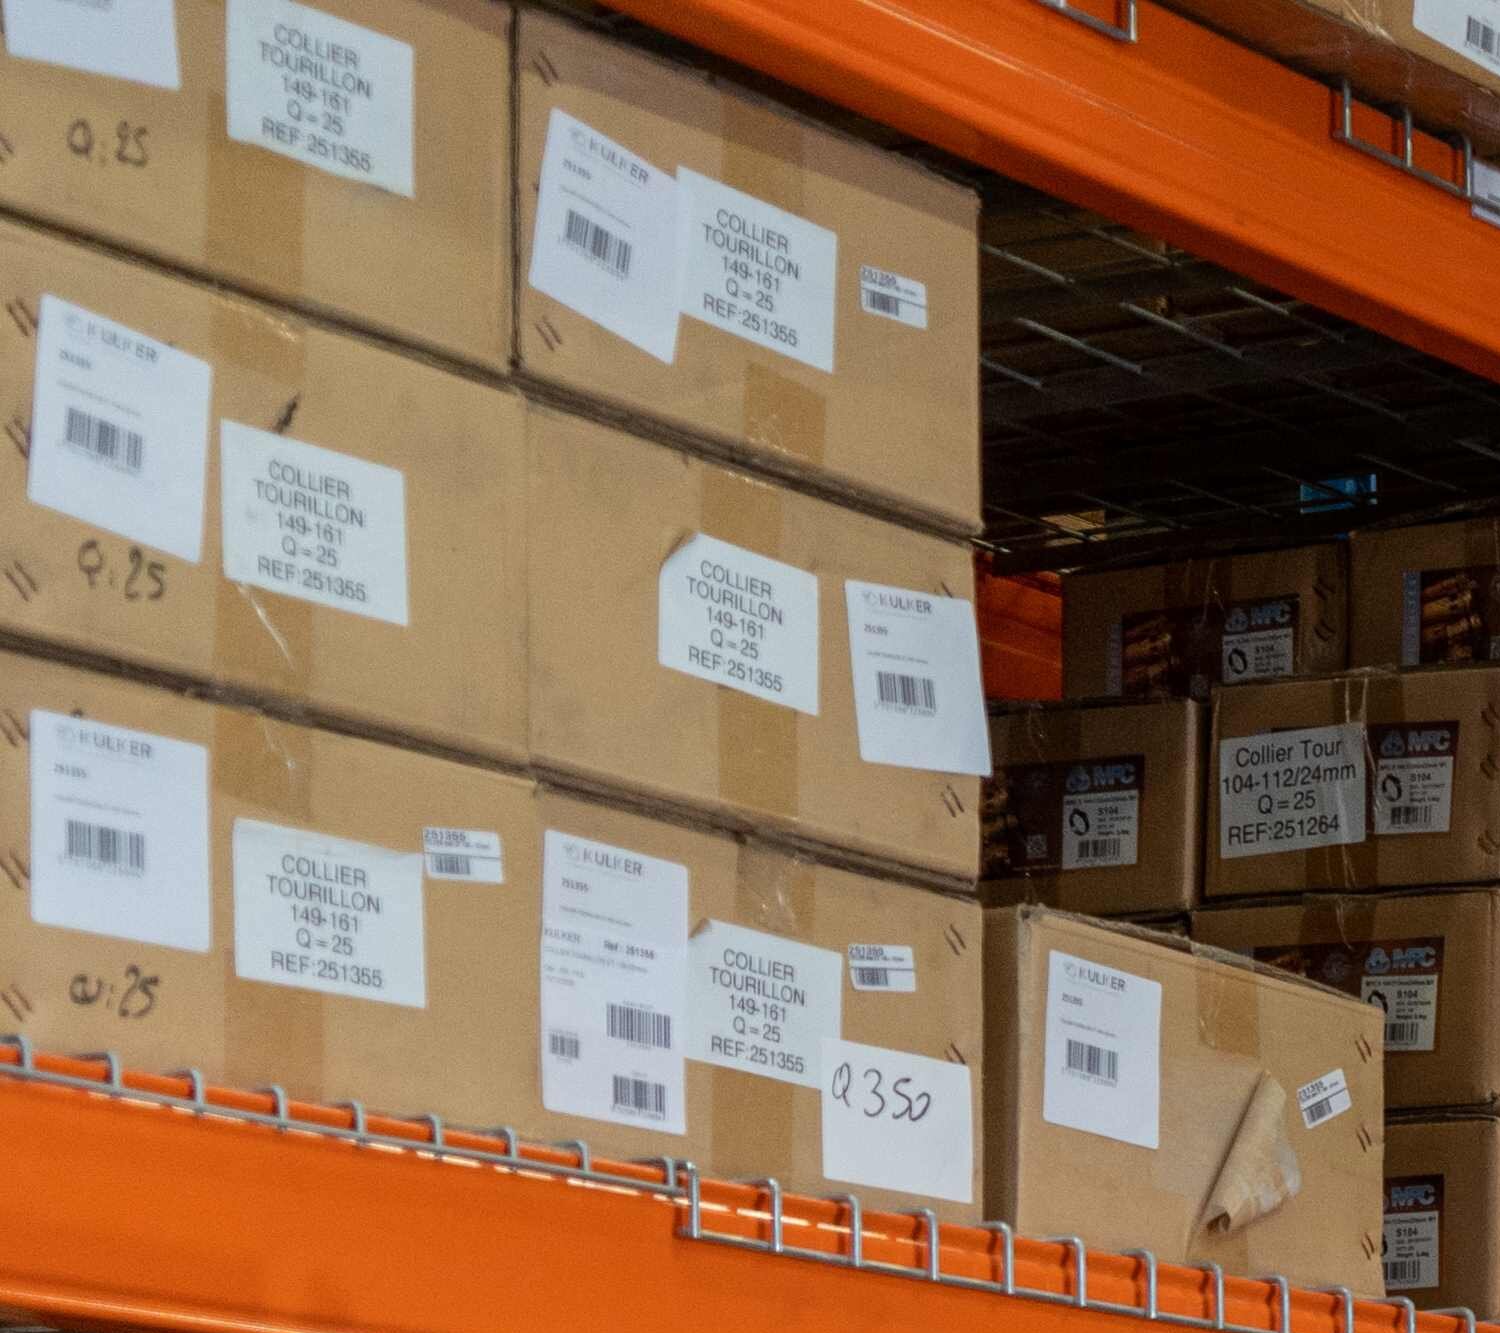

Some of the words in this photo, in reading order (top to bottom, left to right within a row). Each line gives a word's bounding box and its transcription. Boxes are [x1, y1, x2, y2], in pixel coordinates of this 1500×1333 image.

[273, 23, 361, 67] COLLIER
[260, 42, 372, 99] TOURILLON
[281, 77, 350, 113] 149-161
[286, 100, 304, 123] Q
[319, 110, 344, 136] 25
[715, 209, 789, 252] COLLIER
[702, 224, 801, 281] TOURILLON
[721, 256, 781, 294] 149-161
[725, 277, 740, 298] Q
[755, 290, 775, 313] 25
[268, 460, 350, 500] COLLIER
[254, 479, 364, 528] TOURILLON
[276, 513, 345, 545] 149-161
[281, 536, 299, 558] Q
[316, 546, 338, 568] 25
[700, 560, 772, 597] COLLIER
[686, 576, 784, 626] TOURILLON
[879, 592, 932, 614] KULKER
[706, 607, 765, 641] 149-161
[710, 628, 725, 650] Q
[739, 639, 759, 660] 25
[1235, 743, 1293, 768] Collier
[1300, 737, 1343, 761] Tour
[1222, 762, 1356, 796] 104-112/24mm
[1257, 795, 1274, 816] Q
[1293, 792, 1317, 811] 25
[1228, 815, 1340, 849] REF:251264
[280, 853, 367, 887] COLLIER
[583, 848, 643, 876] KULKER
[266, 874, 381, 915] TOURILLON
[289, 904, 361, 933] 149-161
[295, 930, 313, 951] Q
[331, 933, 354, 956] 25
[270, 953, 383, 988] REF:251355
[722, 948, 795, 983] COLLIER
[709, 967, 806, 1007] TOURILLON
[728, 995, 788, 1023] 149-161
[732, 1015, 747, 1035] Q
[762, 1024, 781, 1044] 25
[832, 1062, 850, 1107] Q
[864, 1068, 932, 1121] 350
